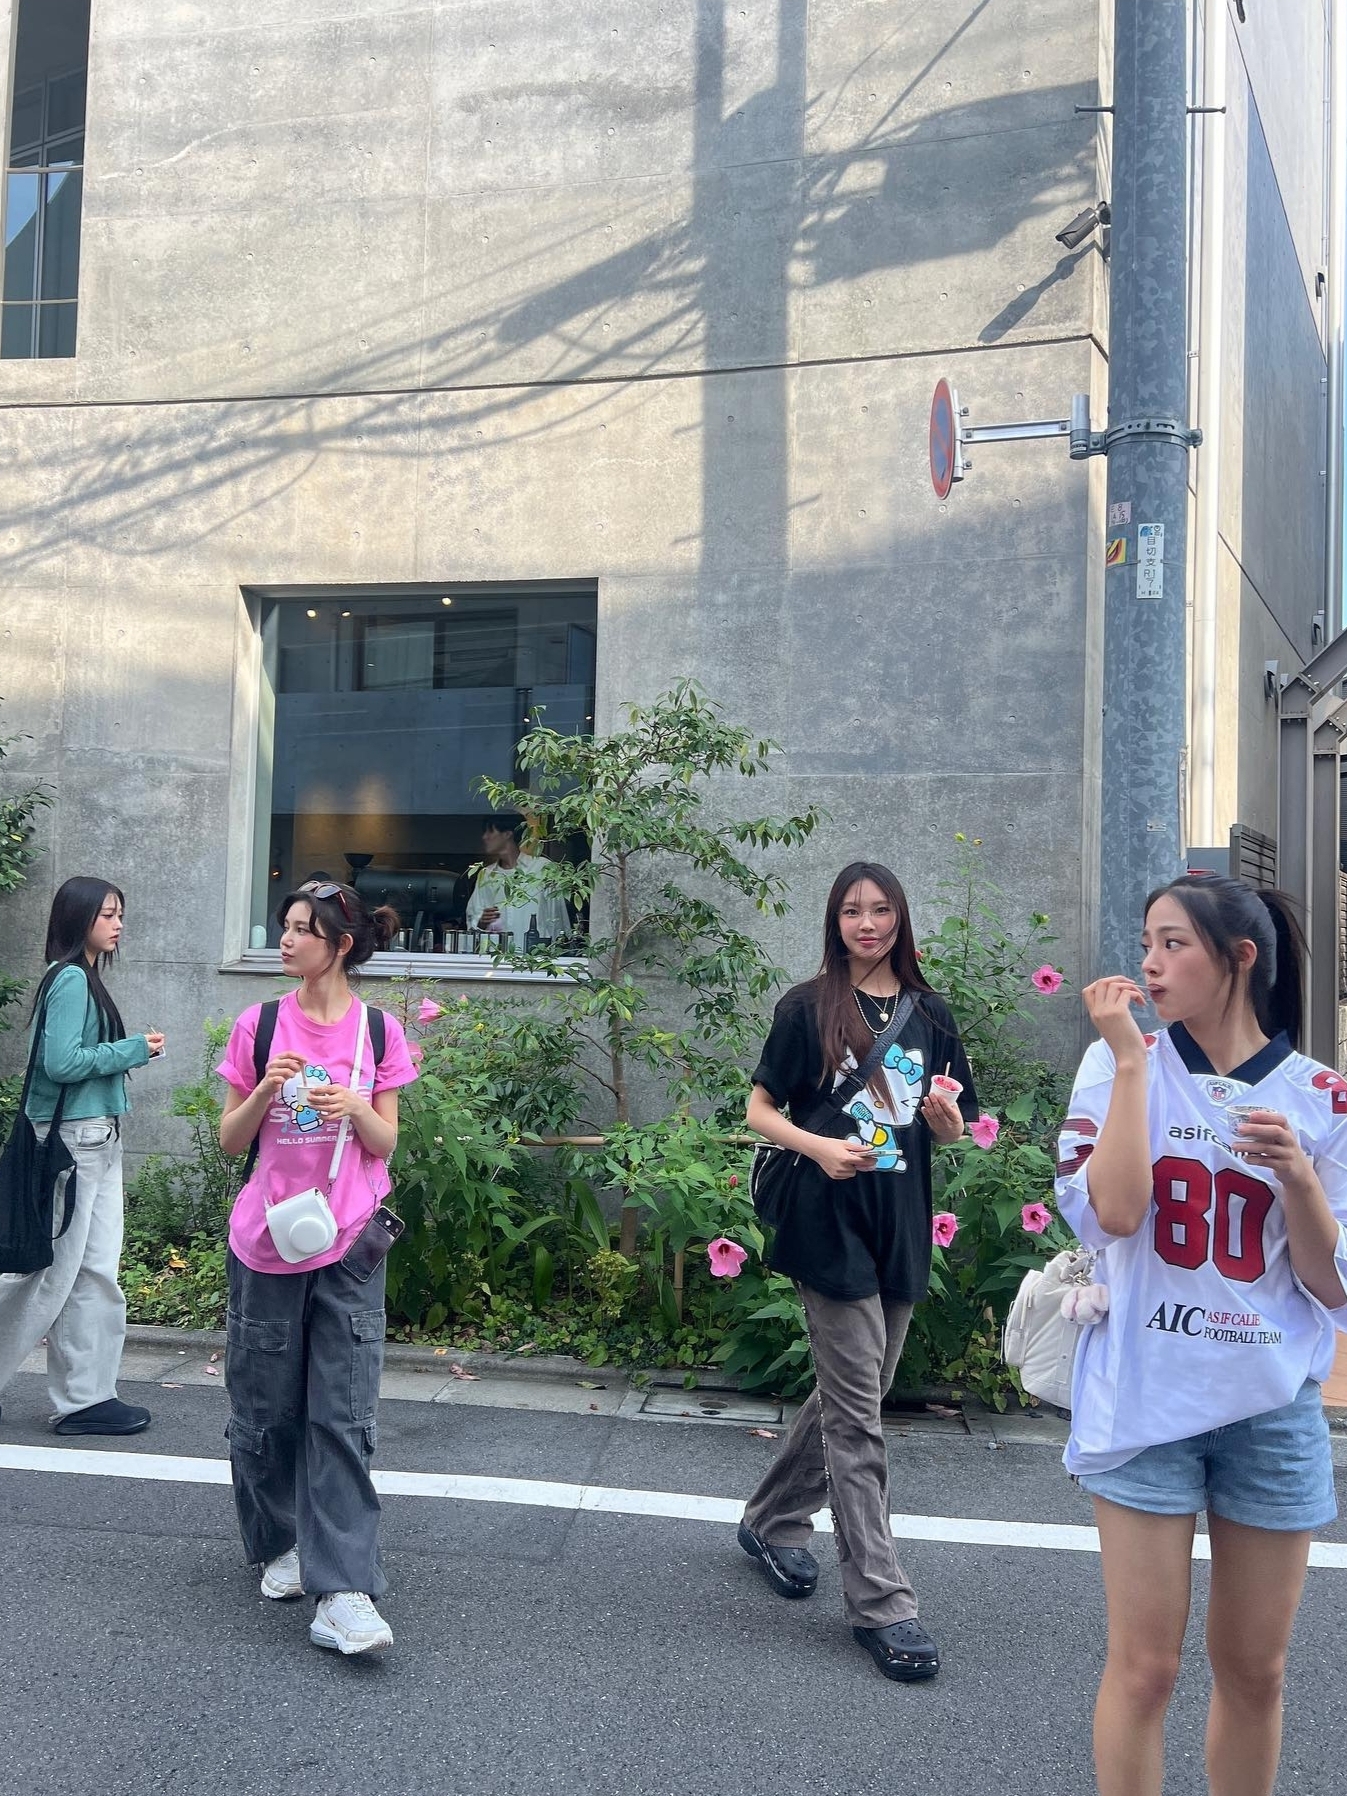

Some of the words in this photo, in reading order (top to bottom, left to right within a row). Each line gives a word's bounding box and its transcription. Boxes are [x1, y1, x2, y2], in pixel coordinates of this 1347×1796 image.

[1152, 1155, 1275, 1284] 80
[1146, 1301, 1206, 1336] AIC
[1231, 1313, 1260, 1326] CALIE
[1204, 1326, 1257, 1343] FOOTBALL
[1258, 1331, 1282, 1344] TEAM
